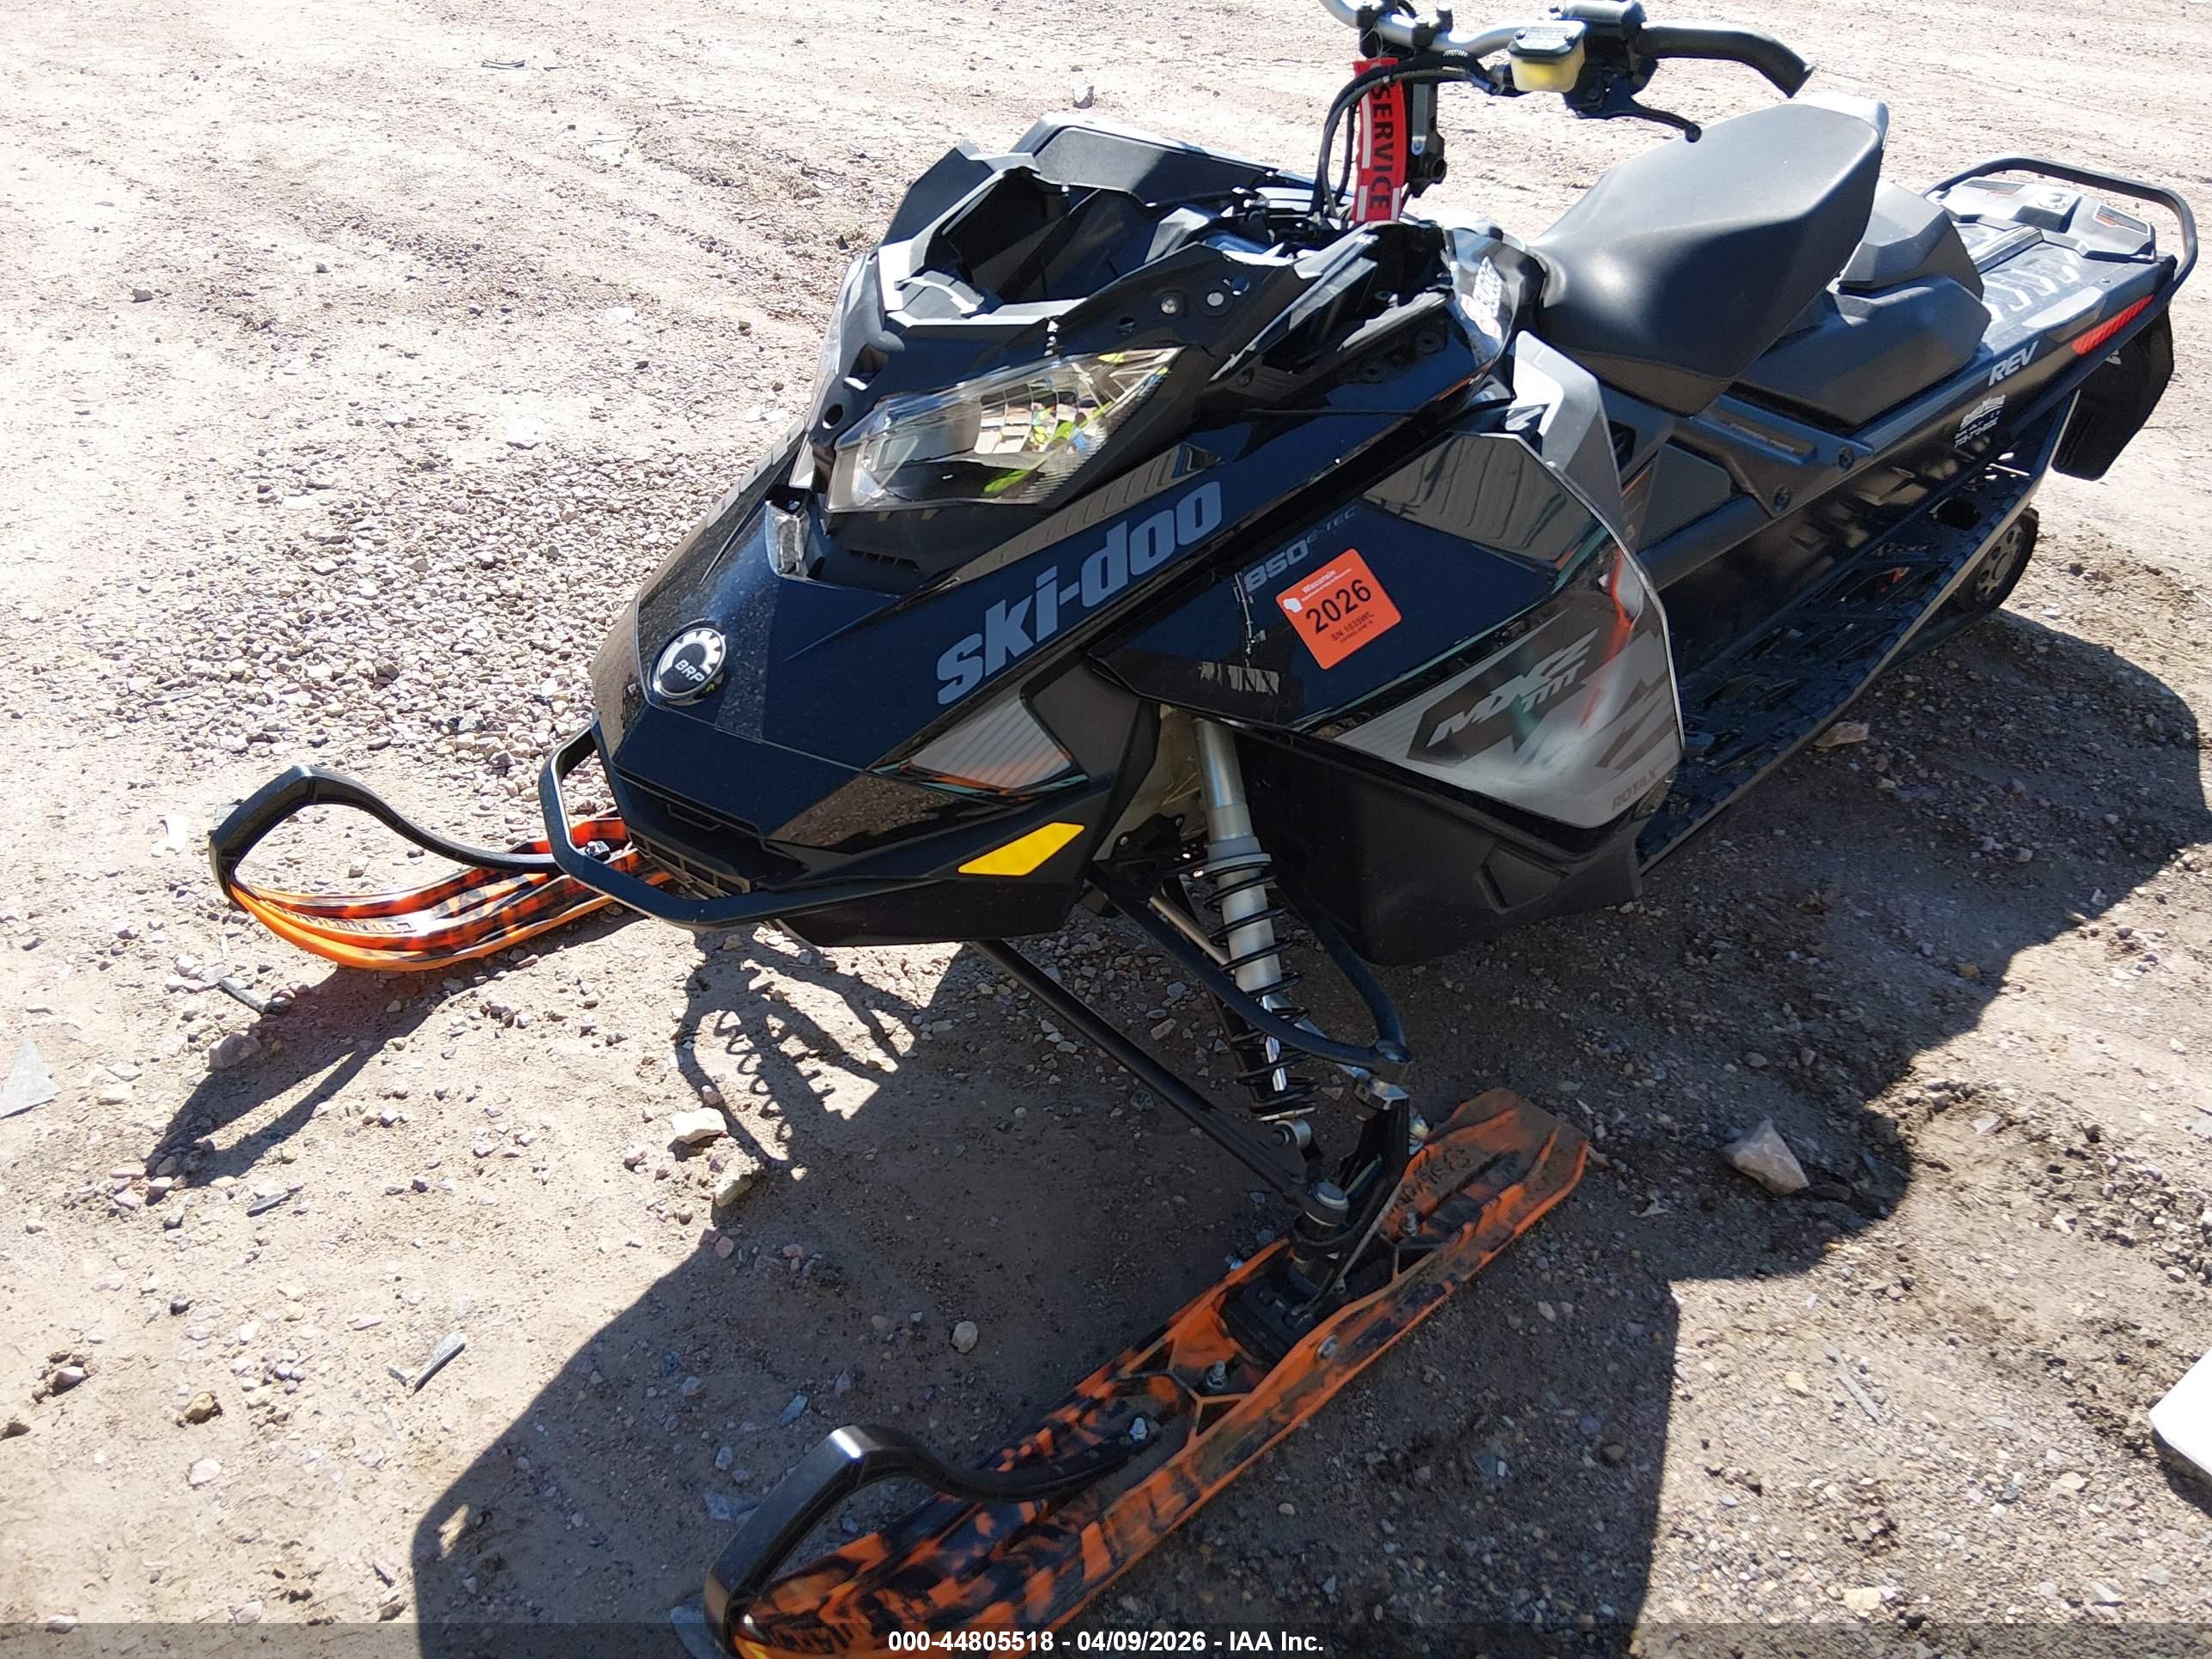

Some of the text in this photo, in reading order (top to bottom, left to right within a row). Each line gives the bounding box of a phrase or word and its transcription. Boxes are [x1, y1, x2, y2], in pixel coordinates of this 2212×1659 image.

[1370, 83, 1395, 210] SERVICE
[1988, 341, 2040, 386] REV
[1245, 539, 1310, 592] 850
[936, 480, 1223, 706] ski-doo
[1305, 579, 1371, 635] 2026
[673, 659, 706, 683] BRP
